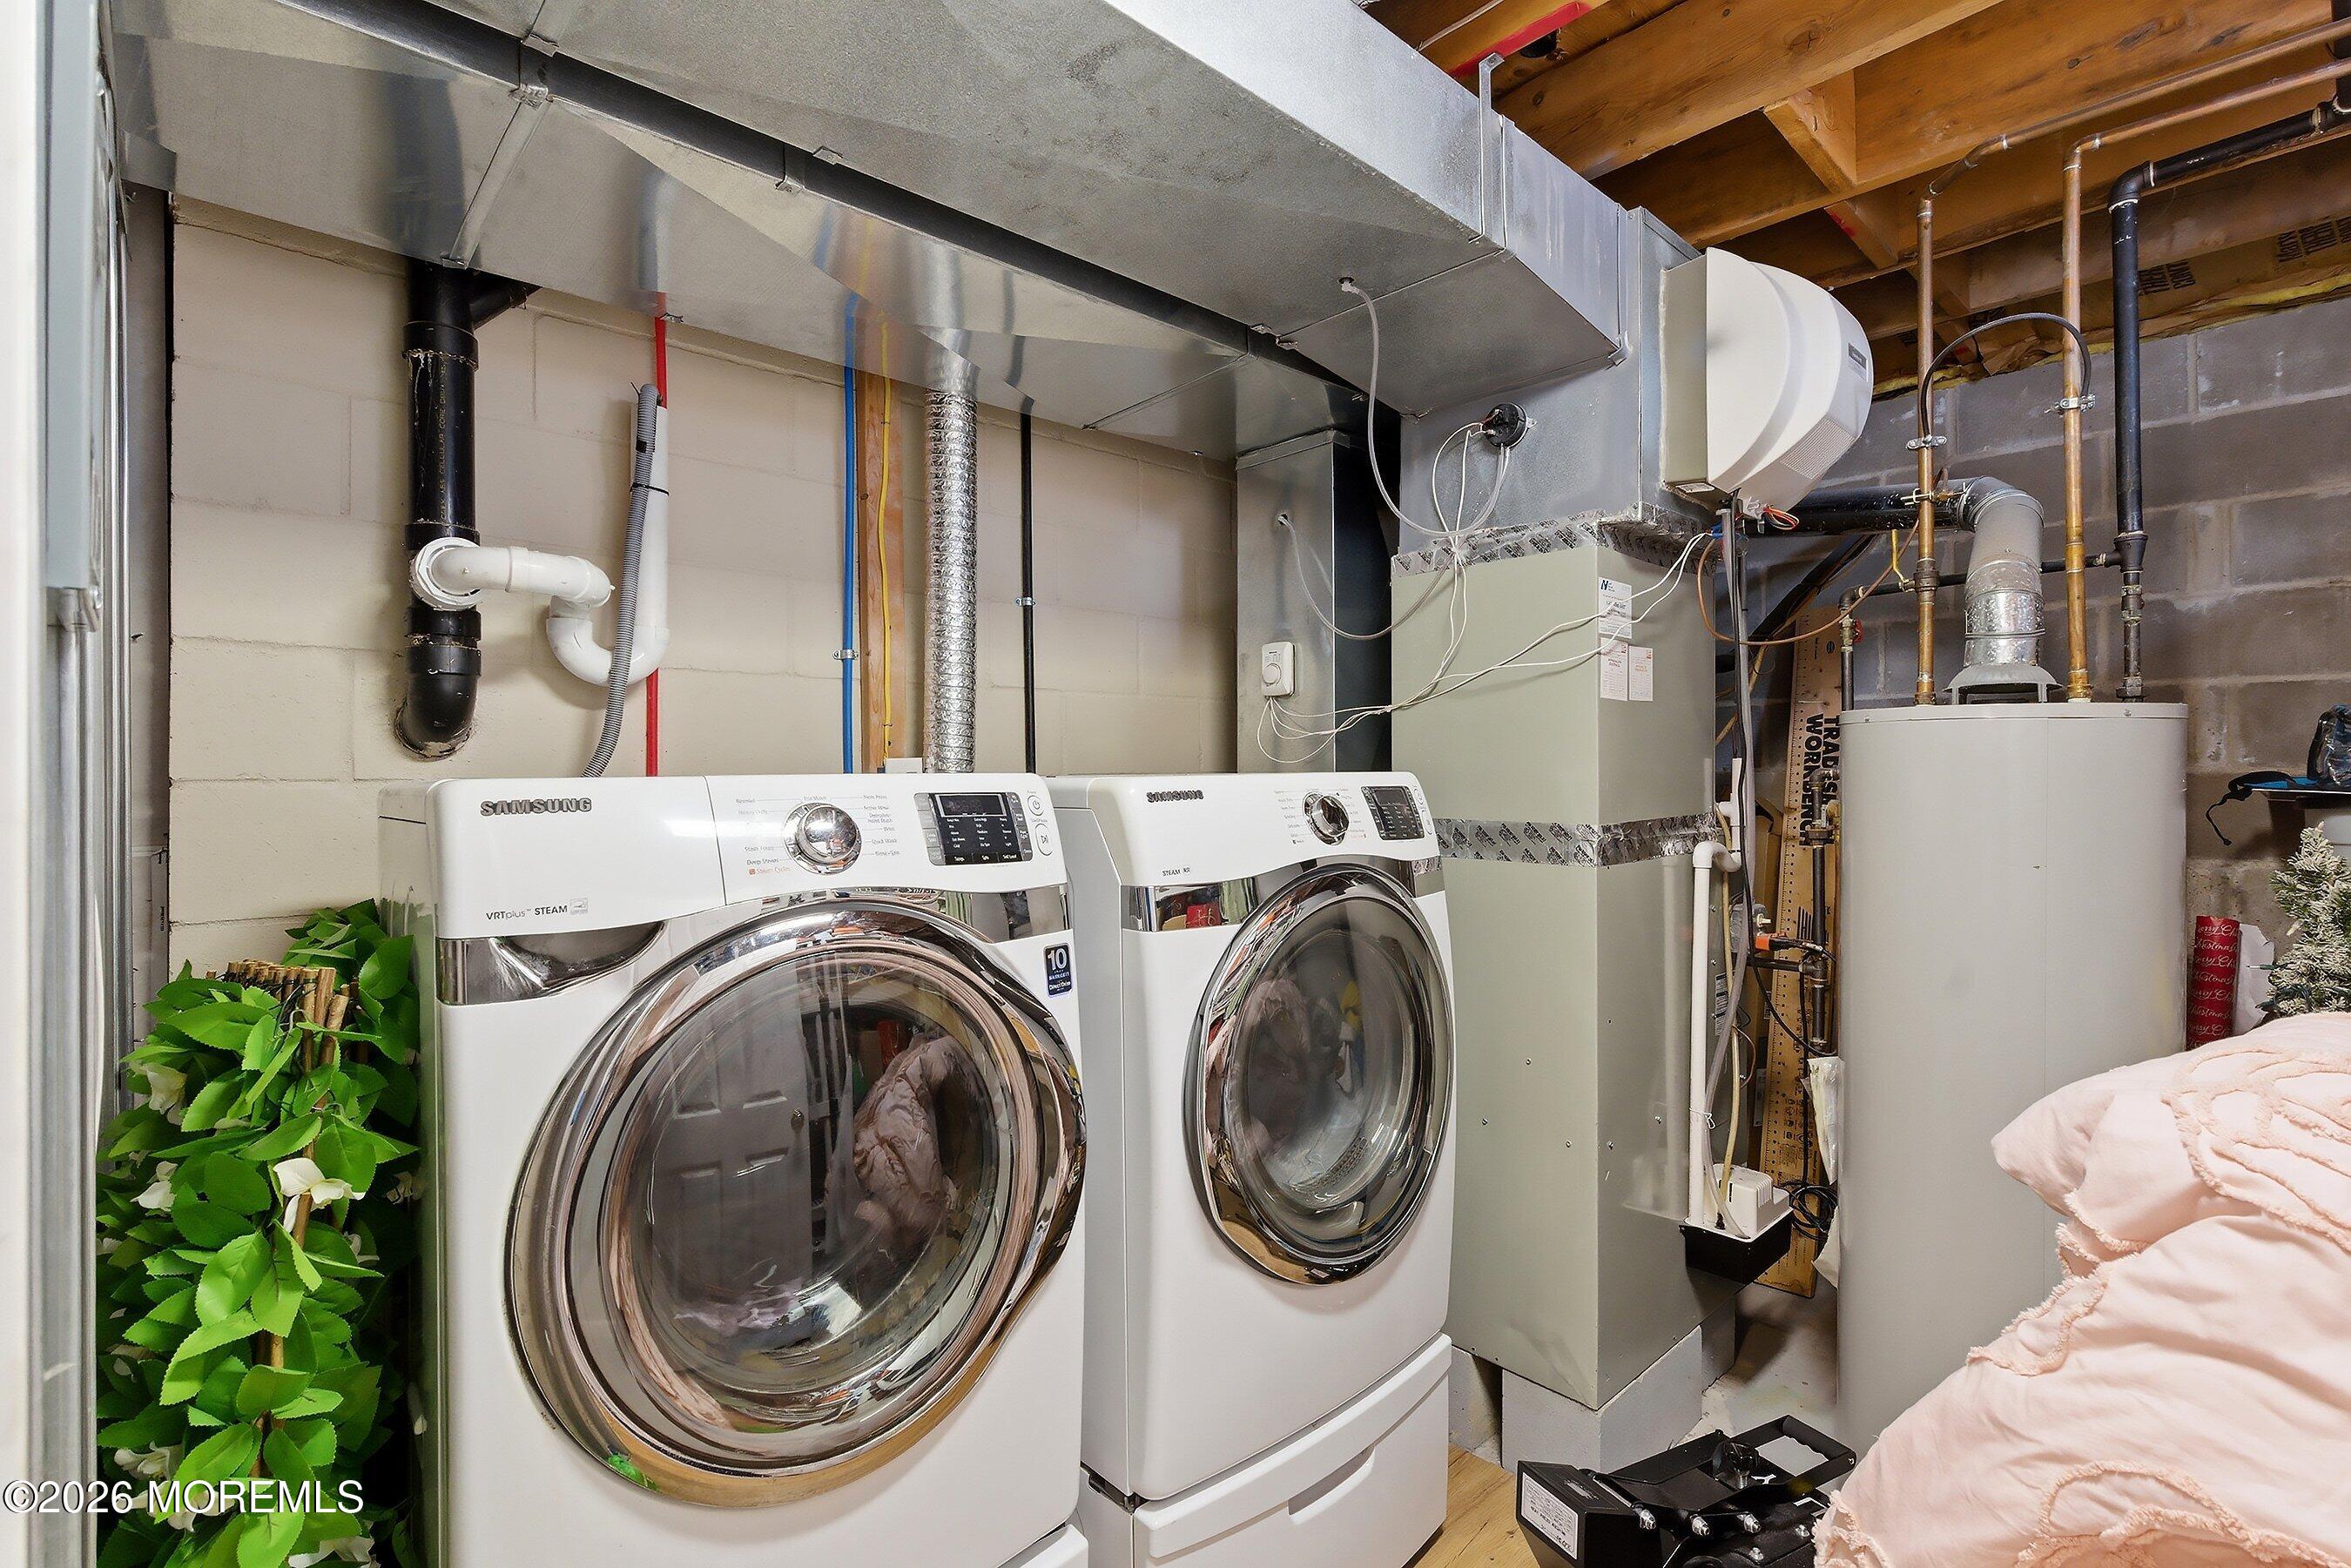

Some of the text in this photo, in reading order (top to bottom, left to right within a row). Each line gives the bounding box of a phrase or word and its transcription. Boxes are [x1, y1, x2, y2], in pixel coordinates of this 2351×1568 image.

[1147, 790, 1203, 803] SAMSUNG
[481, 797, 592, 817] SAMSUNG
[535, 905, 568, 916] STEAM
[1048, 948, 1068, 971] 10
